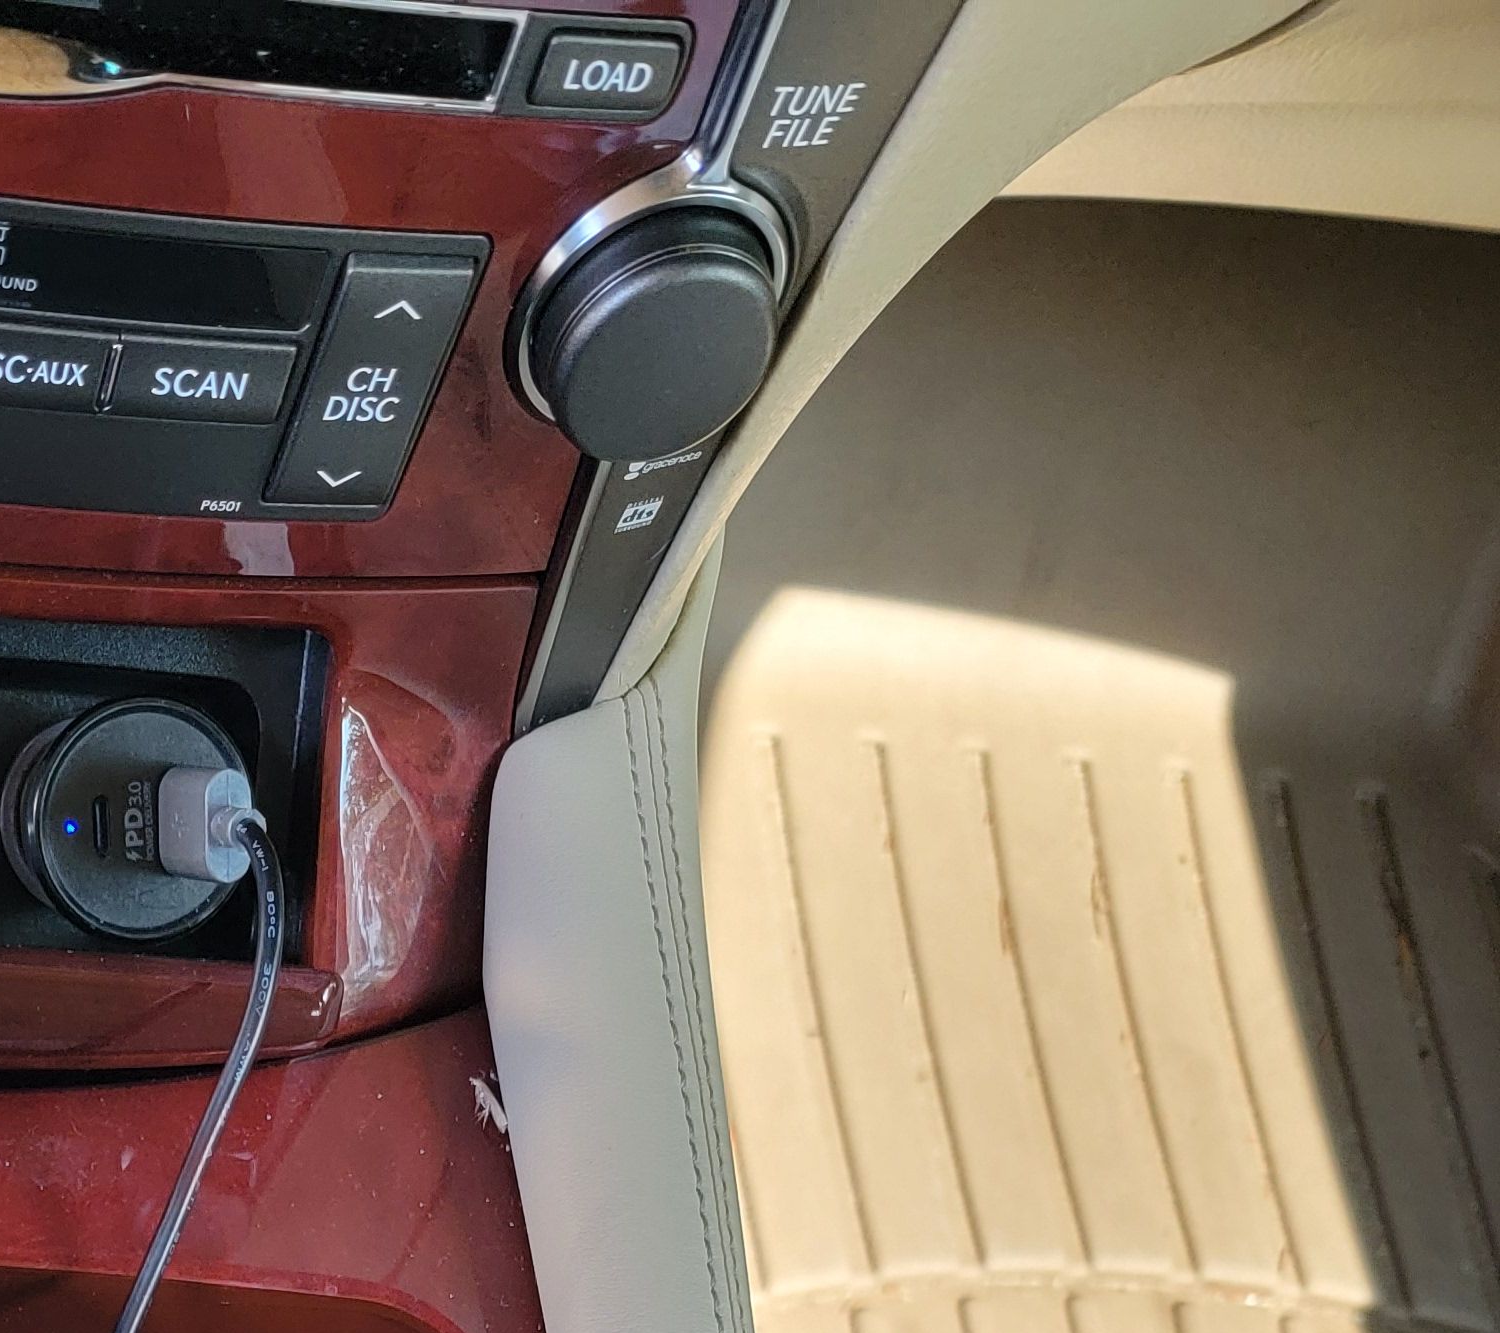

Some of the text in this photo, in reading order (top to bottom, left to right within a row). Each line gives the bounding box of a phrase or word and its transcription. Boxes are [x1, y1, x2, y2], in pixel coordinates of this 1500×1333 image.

[563, 59, 653, 93] LOAD
[769, 82, 867, 117] TUNE
[762, 116, 841, 149] FILE
[151, 367, 250, 401] SCAN
[347, 367, 397, 393] CH
[323, 395, 399, 423] DISC
[200, 499, 242, 513] P6501
[124, 781, 145, 848] PD 3.0
